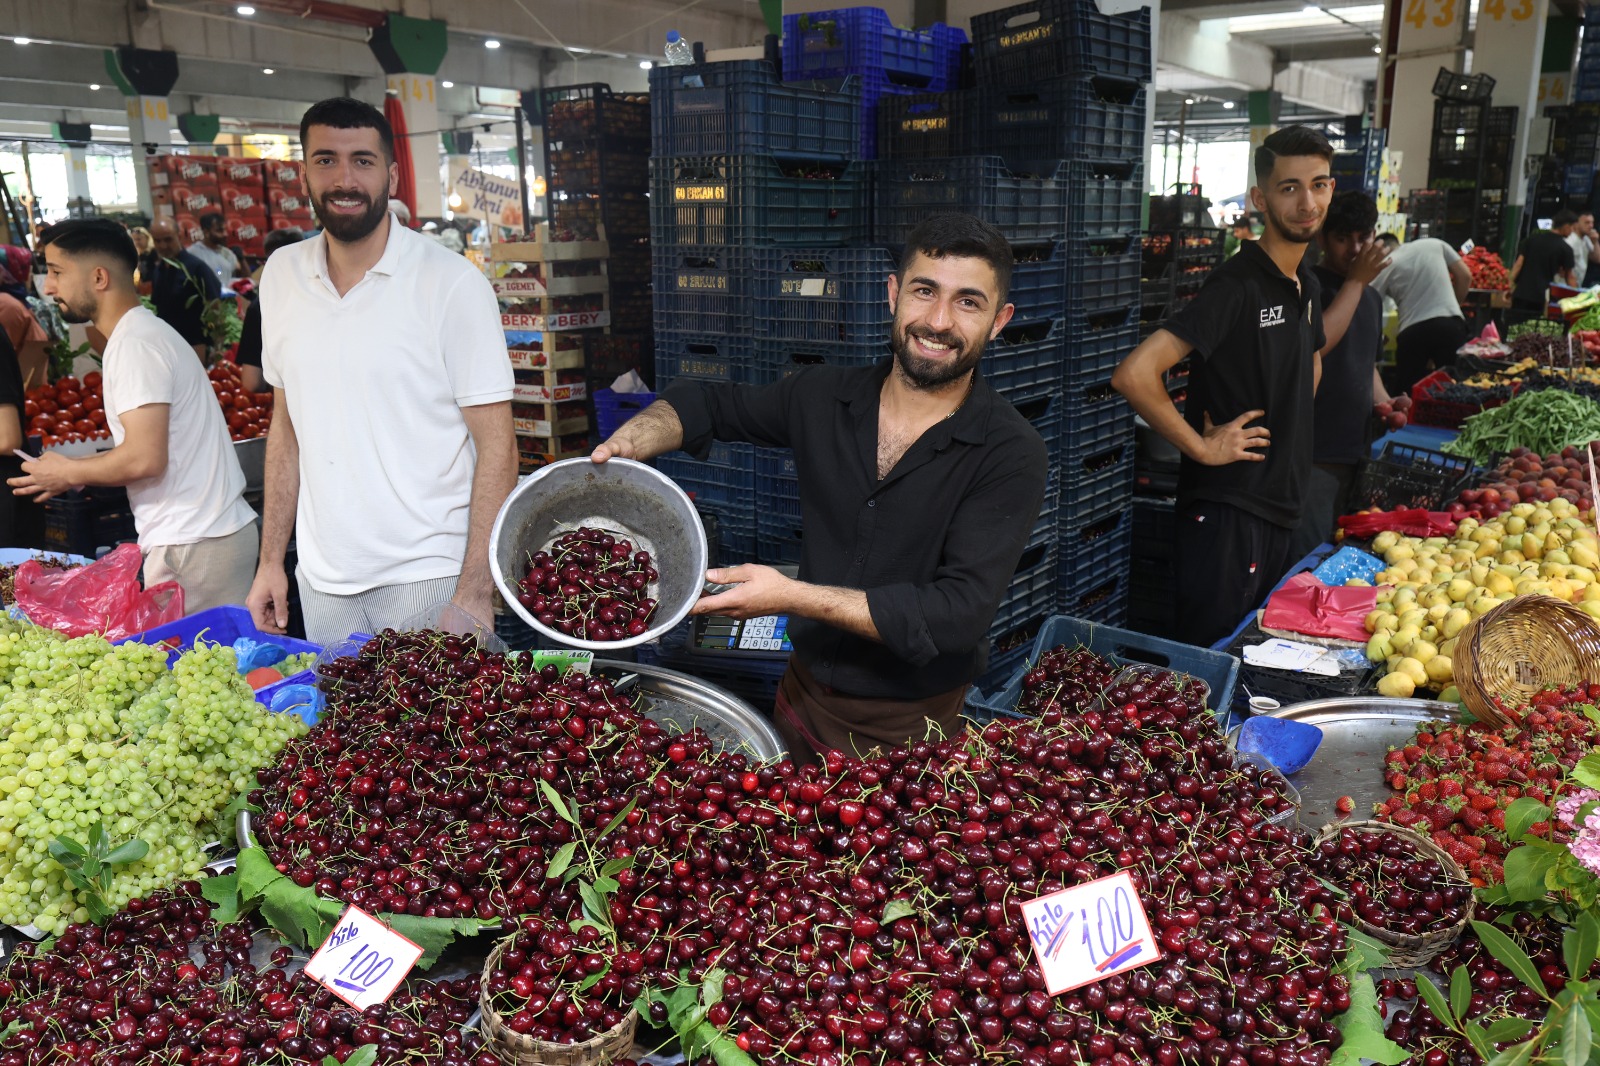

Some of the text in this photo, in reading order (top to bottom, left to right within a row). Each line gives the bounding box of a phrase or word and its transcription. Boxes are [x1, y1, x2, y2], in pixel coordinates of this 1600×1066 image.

[1404, 0, 1454, 29] 43
[1484, 0, 1533, 21] 43
[413, 79, 434, 103] 41
[687, 187, 713, 199] ERKAN
[715, 186, 724, 199] 61
[473, 193, 503, 214] Yeri
[506, 282, 536, 291] EGEMEY
[502, 314, 538, 326] BERY
[558, 313, 599, 327] BERY
[1260, 305, 1284, 322] EA7
[554, 389, 570, 399] CAN
[329, 921, 359, 947] Kilo
[1031, 902, 1063, 946] Kilo
[1081, 886, 1134, 966] 100
[338, 943, 394, 987] 100
